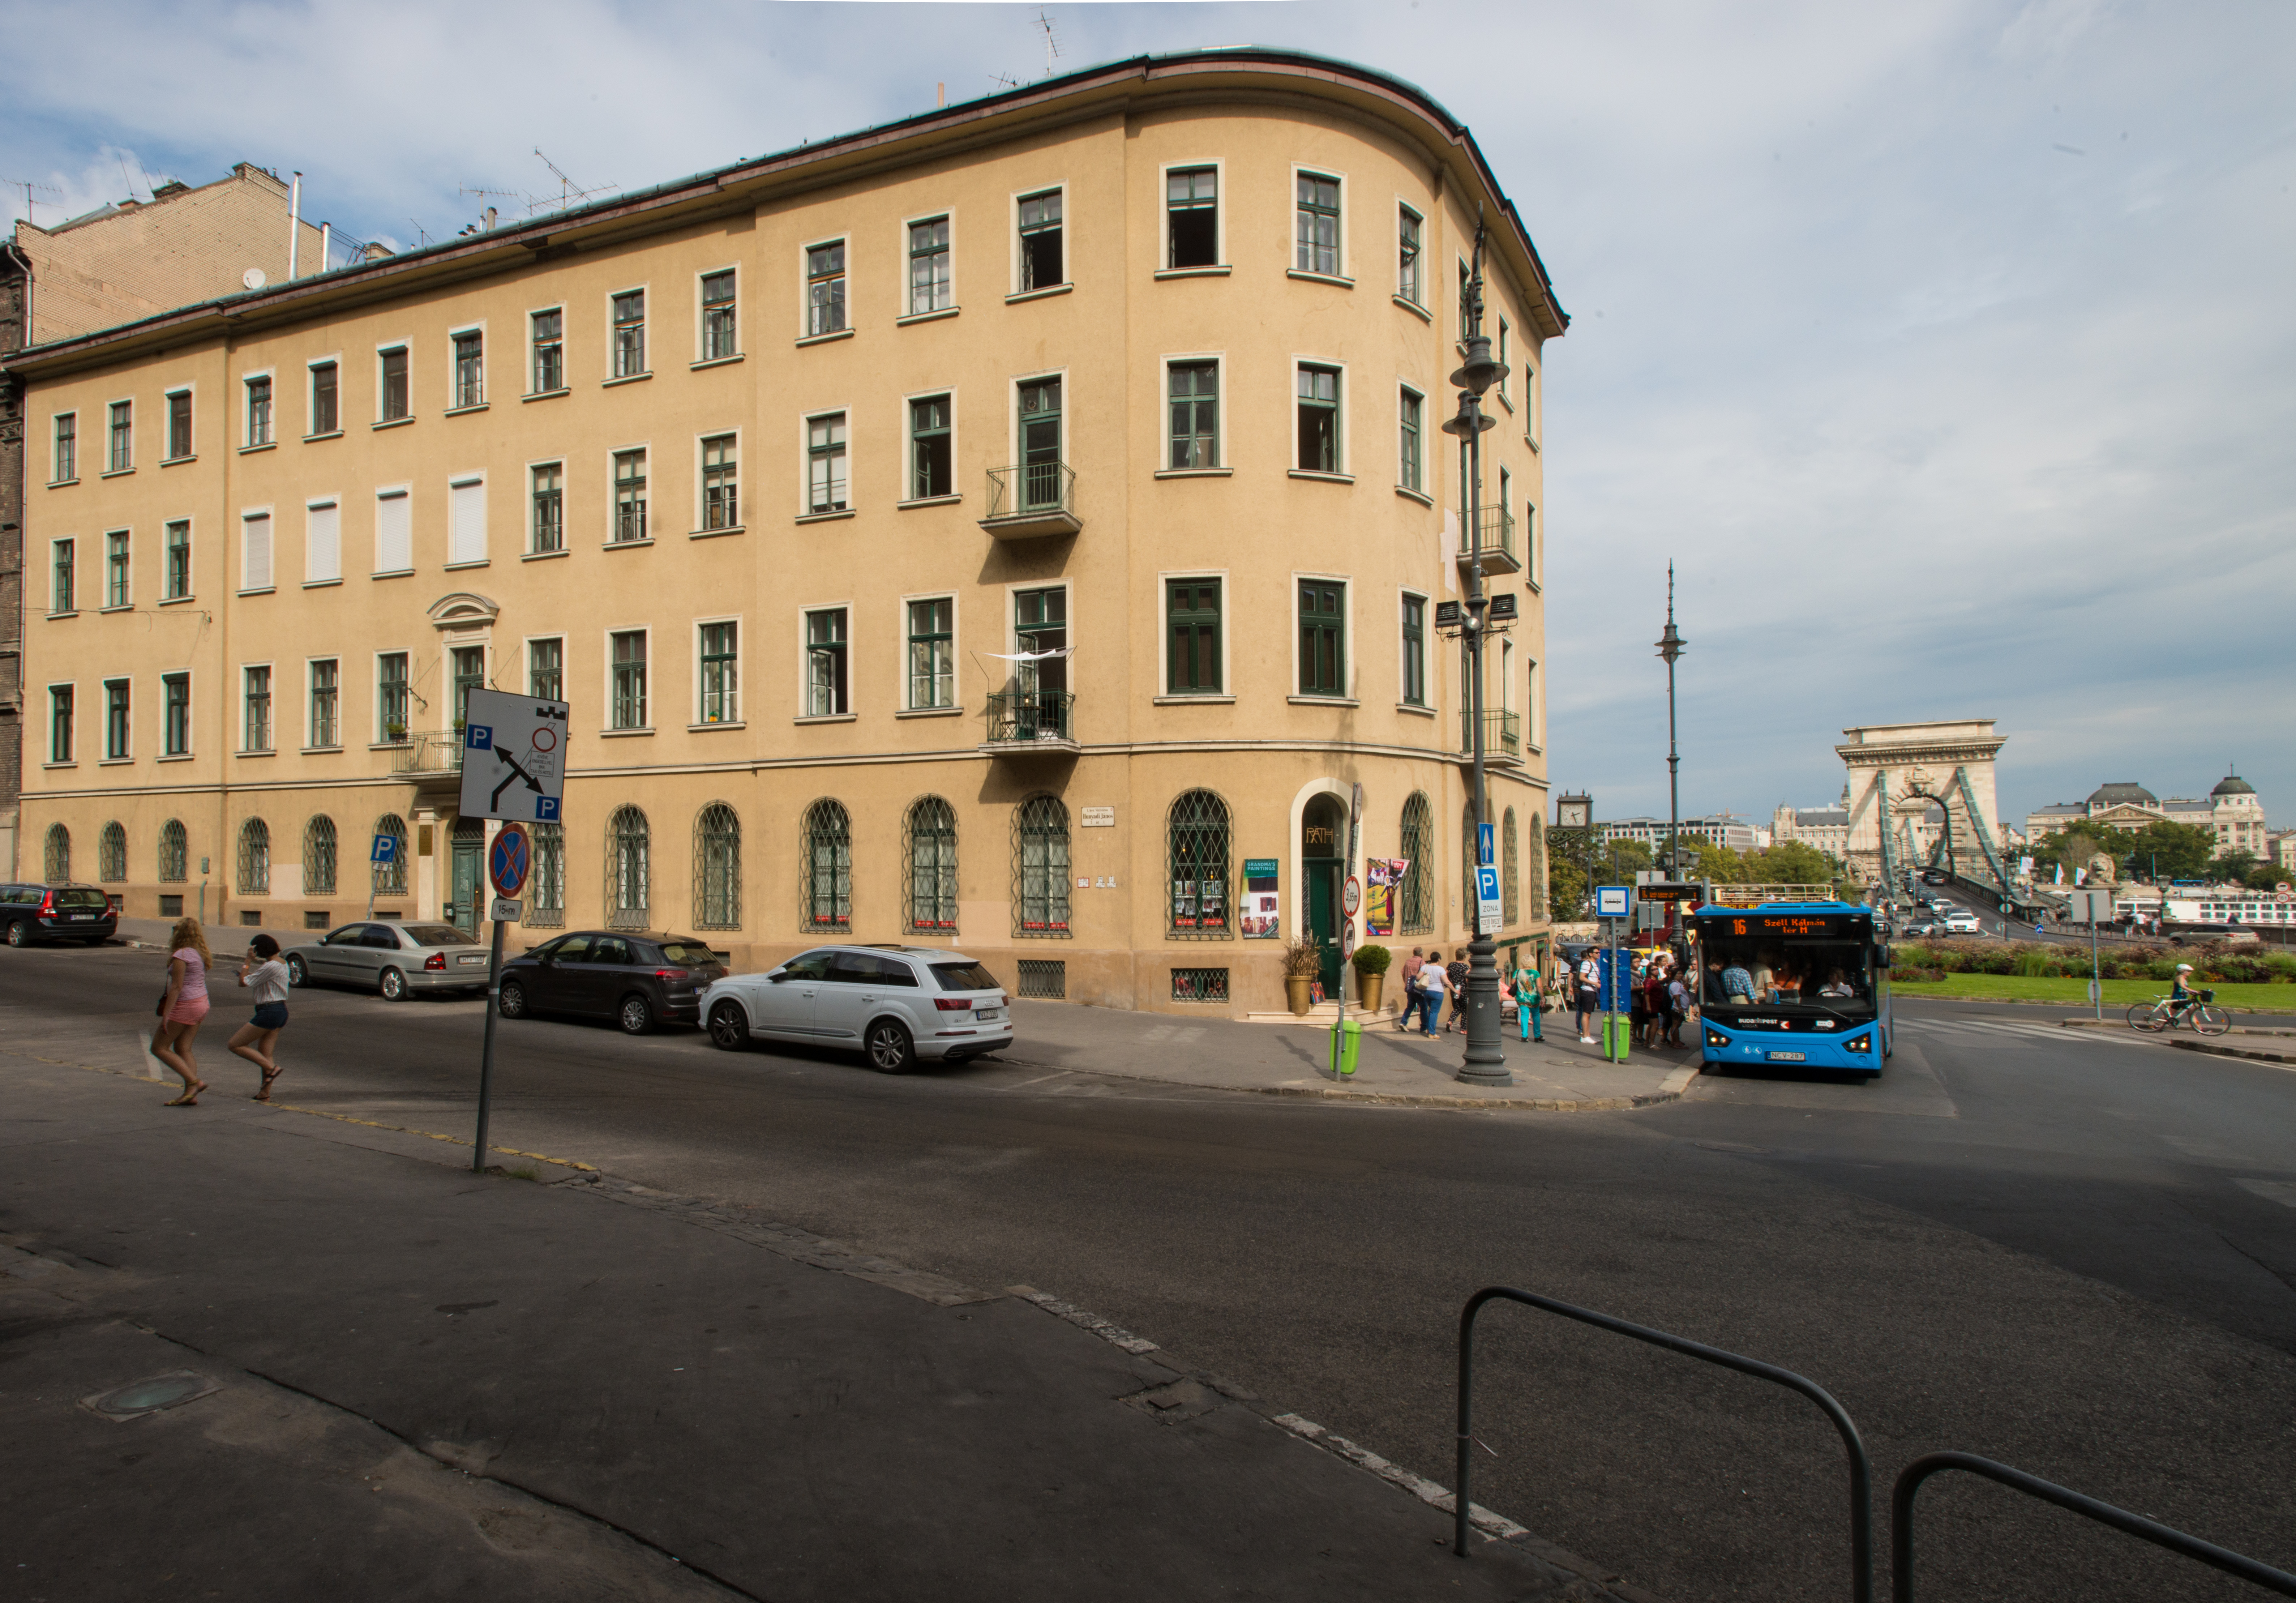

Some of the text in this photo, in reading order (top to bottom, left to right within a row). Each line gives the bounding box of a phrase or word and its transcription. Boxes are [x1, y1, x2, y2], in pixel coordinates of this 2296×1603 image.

[472, 728, 487, 746] P
[542, 799, 555, 817] P
[376, 838, 393, 859] P
[1482, 874, 1494, 895] P
[499, 905, 506, 914] 15
[1733, 919, 1746, 935] 16
